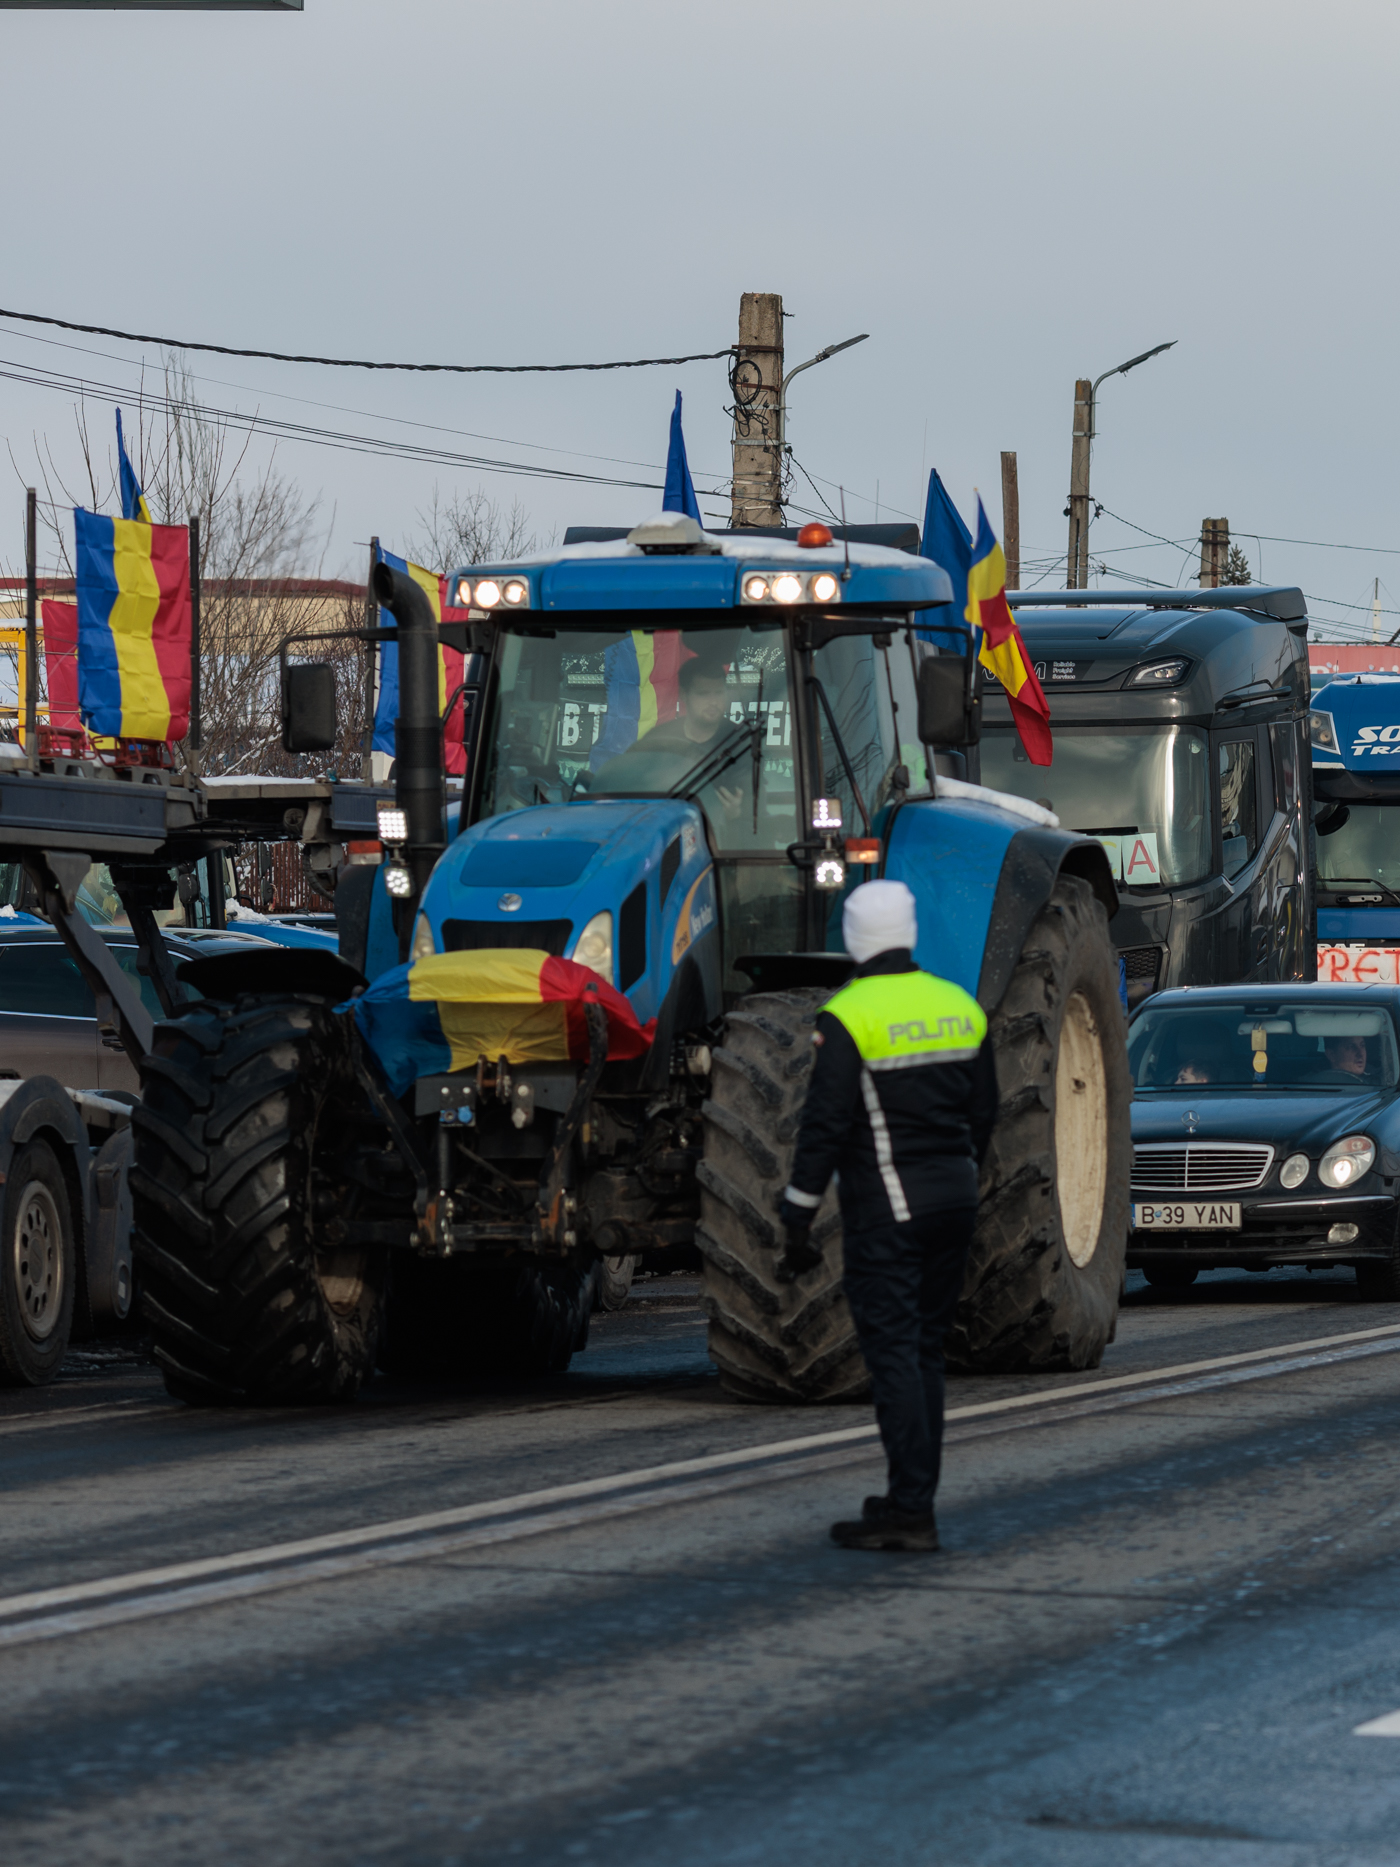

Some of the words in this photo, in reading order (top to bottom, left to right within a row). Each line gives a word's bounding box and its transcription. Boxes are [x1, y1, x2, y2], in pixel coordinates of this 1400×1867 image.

[1141, 1205, 1155, 1225] B
[1162, 1205, 1185, 1225] 39
[1193, 1205, 1233, 1225] YAN
